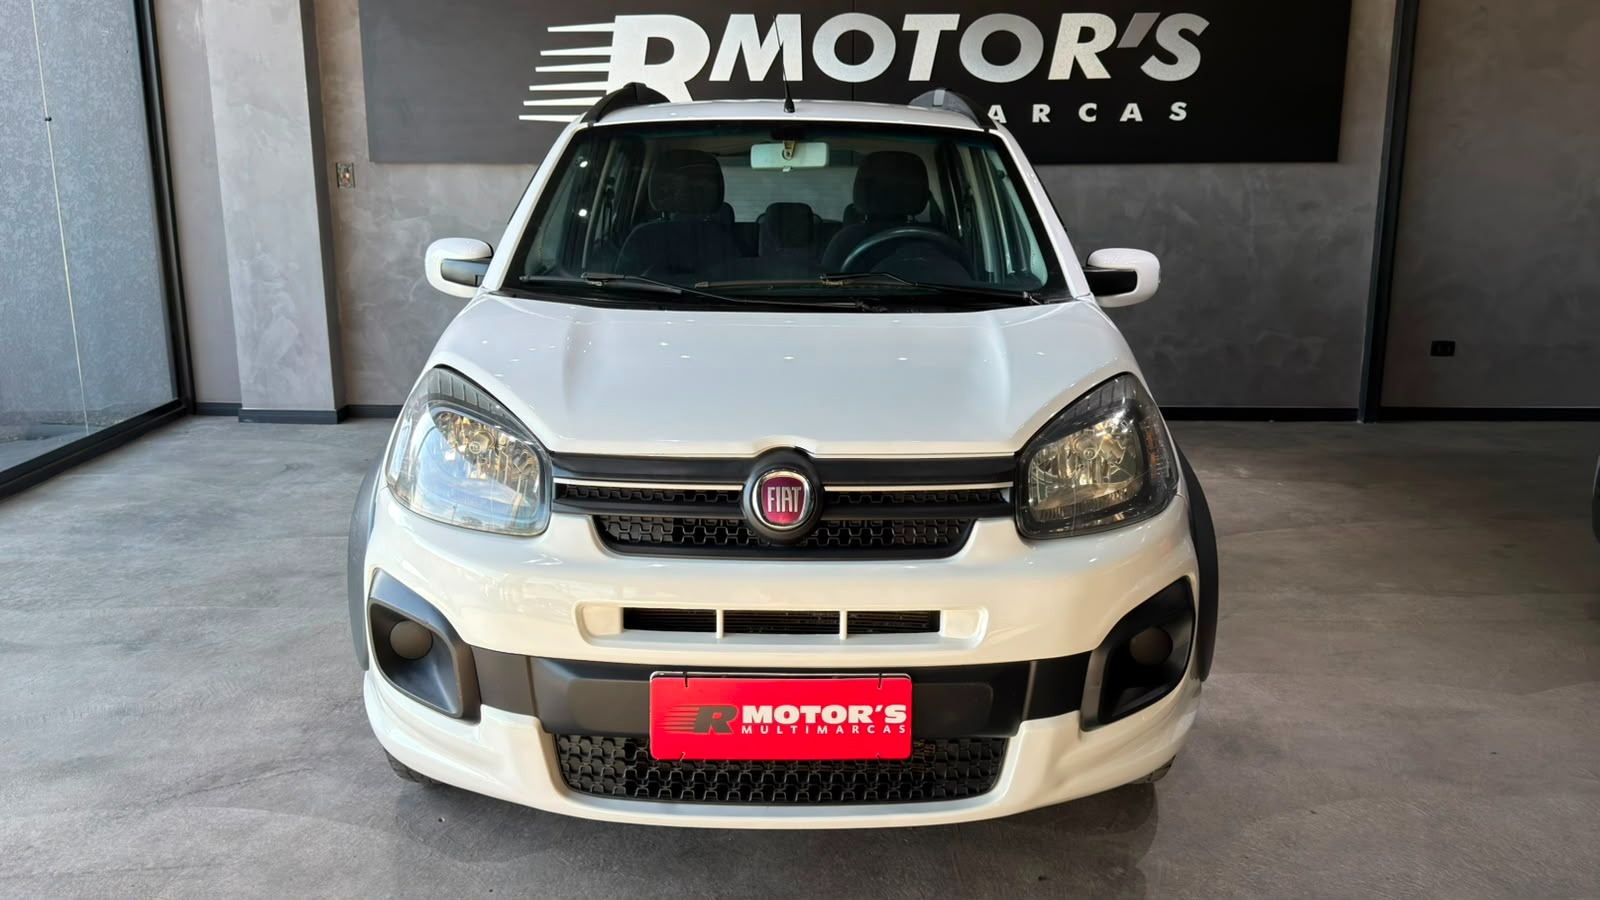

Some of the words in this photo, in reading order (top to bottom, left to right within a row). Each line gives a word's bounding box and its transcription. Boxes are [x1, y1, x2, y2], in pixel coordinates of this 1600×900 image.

[988, 102, 1187, 122] ARCAS
[767, 486, 801, 513] FIAT
[742, 705, 907, 724] MOTOR'S
[741, 725, 906, 735] MULTIMARCAS
